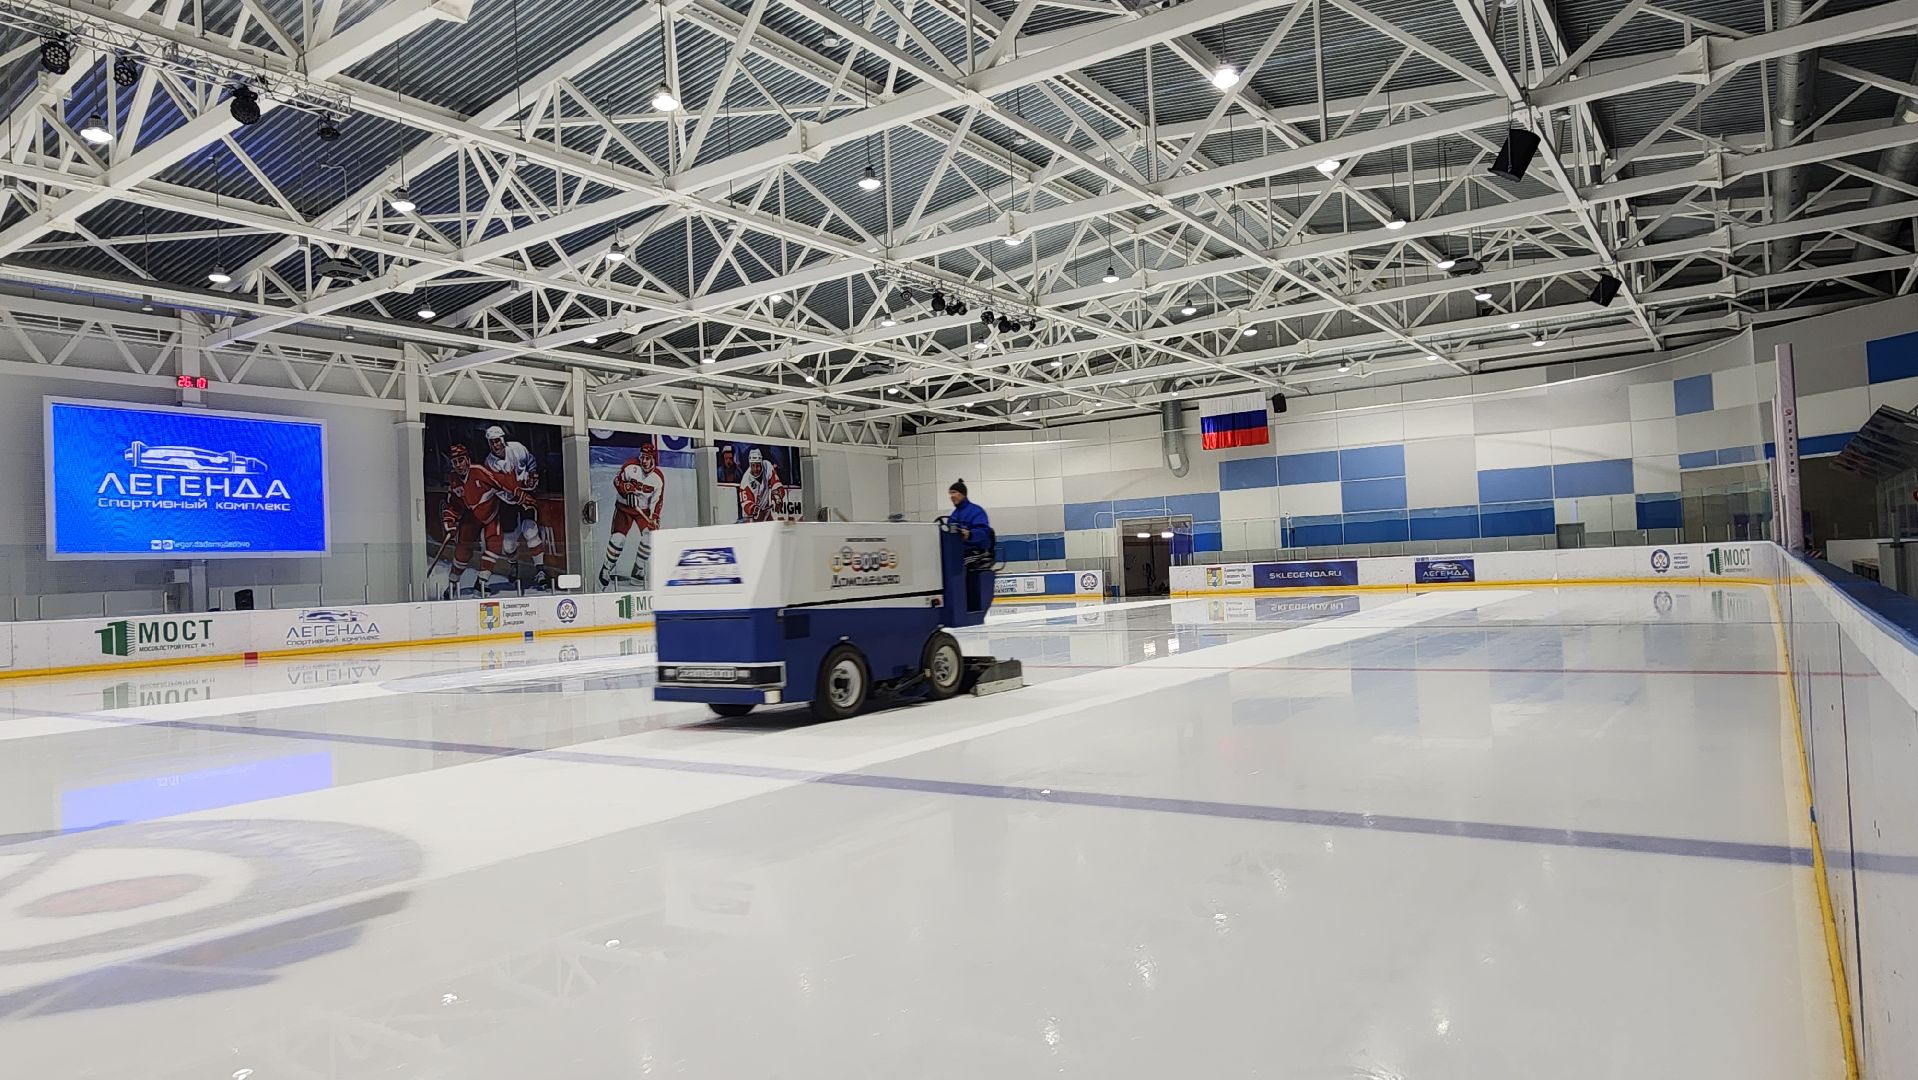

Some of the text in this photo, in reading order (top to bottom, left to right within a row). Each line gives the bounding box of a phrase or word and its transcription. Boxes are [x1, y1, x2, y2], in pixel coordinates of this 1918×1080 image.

[177, 376, 207, 389] 26.10
[97, 472, 291, 499] ЛЕГЕНДА
[215, 501, 291, 511] комплекс
[1723, 548, 1751, 567] МОСТ
[1269, 570, 1342, 580] SKLEGENDA.RU
[1422, 569, 1470, 577] ЛЕГЕНДА
[138, 620, 213, 644] МОСТ
[286, 622, 380, 639] ЛЕГЕНДА
